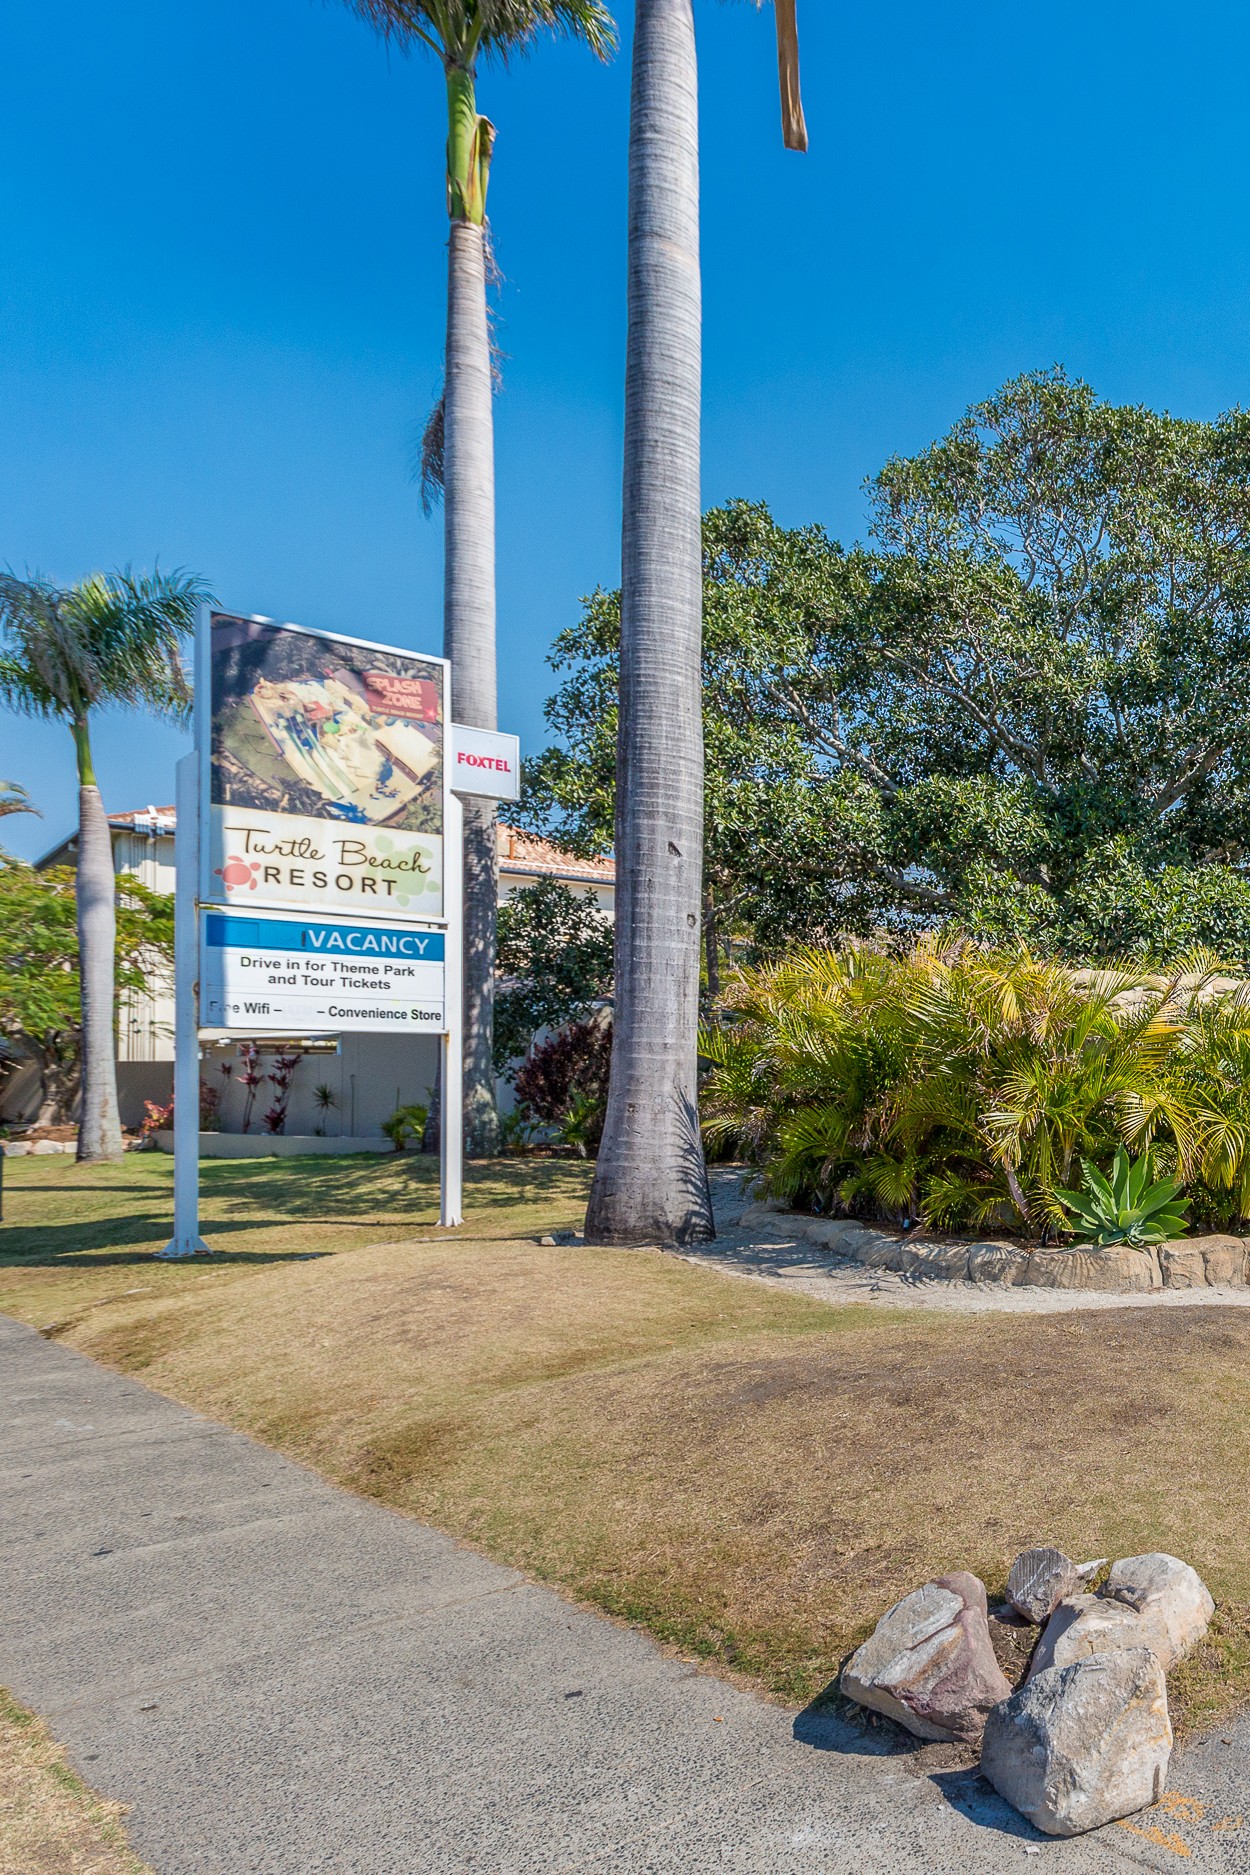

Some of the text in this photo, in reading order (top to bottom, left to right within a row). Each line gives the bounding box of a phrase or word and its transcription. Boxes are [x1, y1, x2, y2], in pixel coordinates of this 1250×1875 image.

[366, 677, 422, 695] SPLASH
[382, 690, 422, 710] ZONE
[457, 752, 511, 773] FOXTEL
[224, 826, 431, 874] Turtle Beach
[264, 866, 397, 896] RESORT
[308, 929, 430, 955] VACANCY
[240, 956, 415, 977] Drive in for Theme Park
[268, 974, 391, 990] and Tour Tickets
[244, 1002, 270, 1015] Wifi
[328, 1006, 408, 1020] Convenience
[410, 1008, 442, 1021] Store
